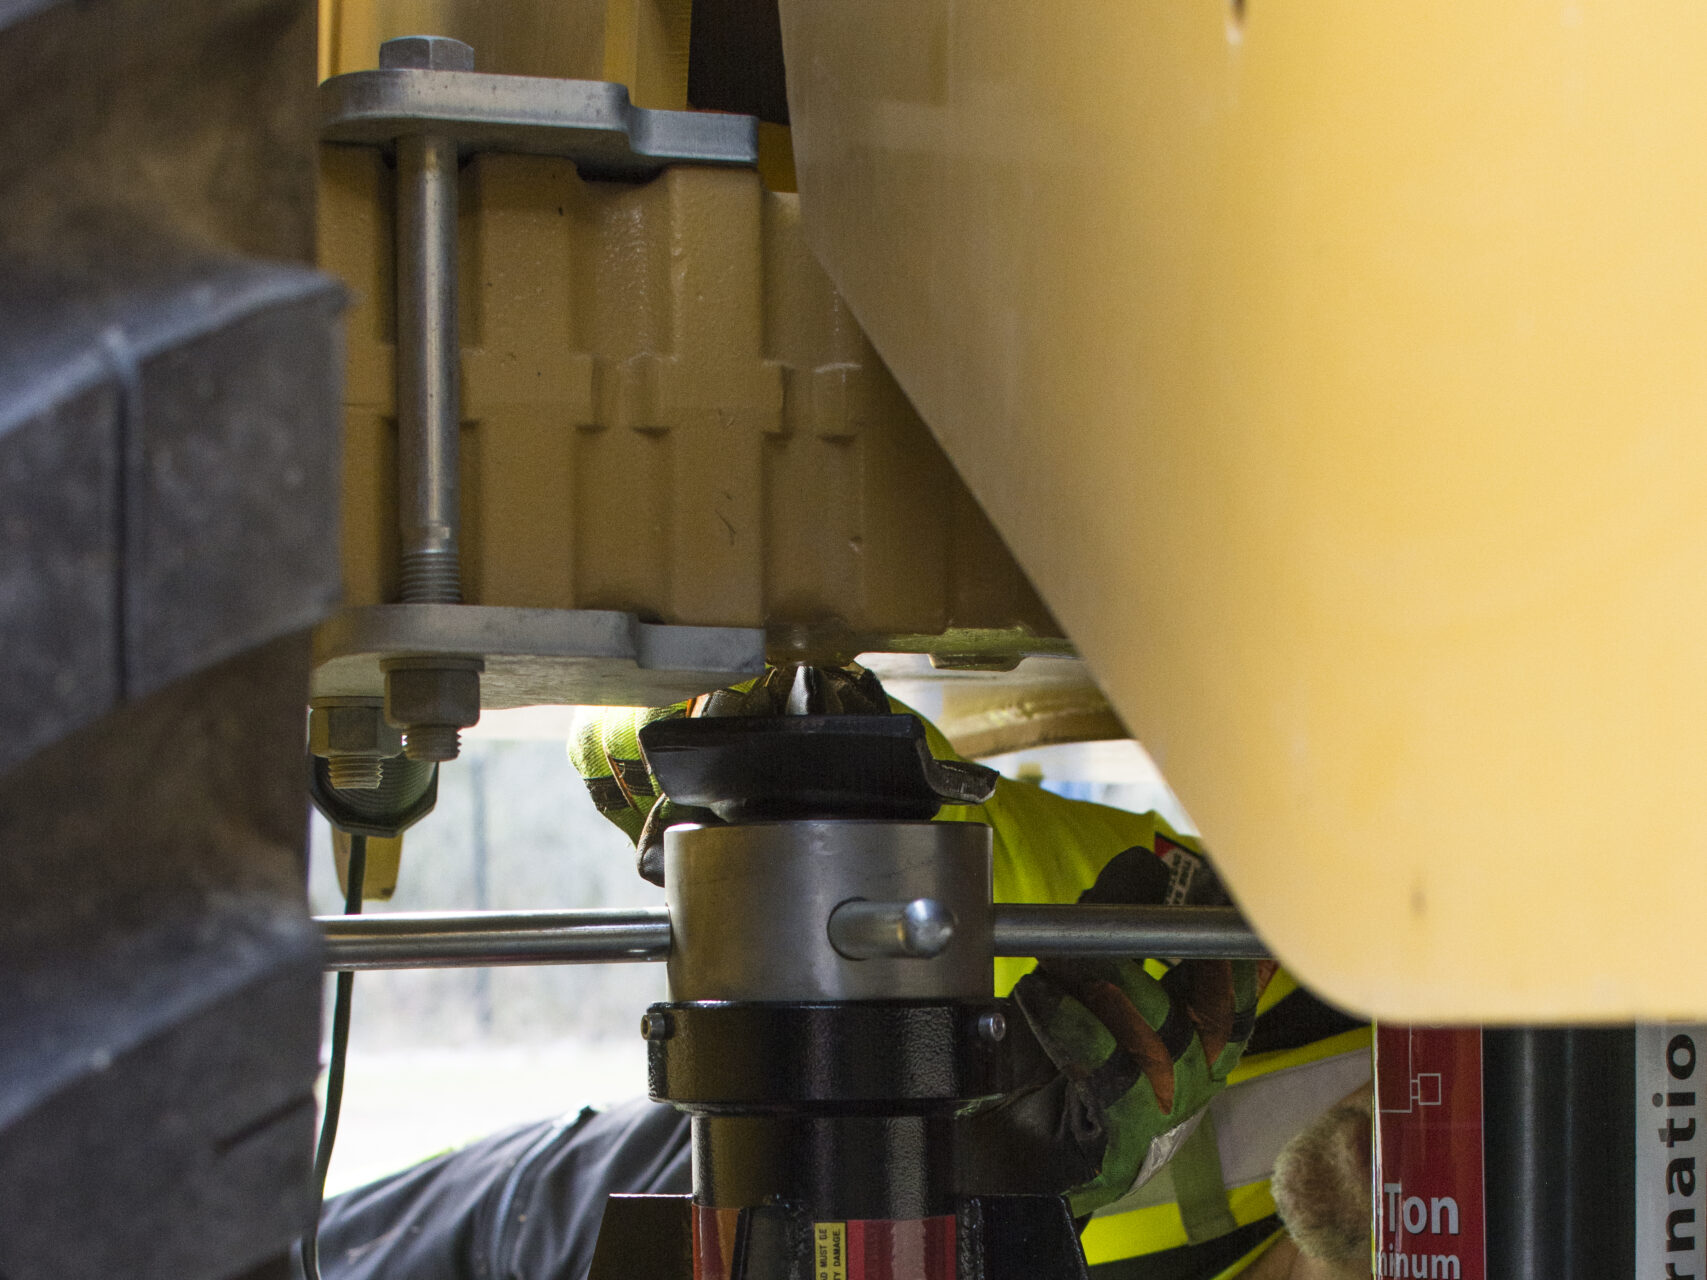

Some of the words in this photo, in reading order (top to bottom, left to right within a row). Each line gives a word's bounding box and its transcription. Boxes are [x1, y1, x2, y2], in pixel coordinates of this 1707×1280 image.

[1384, 1182, 1460, 1235] Ton
[819, 1245, 828, 1267] MUST
[832, 1229, 841, 1267] DAMAGE.
